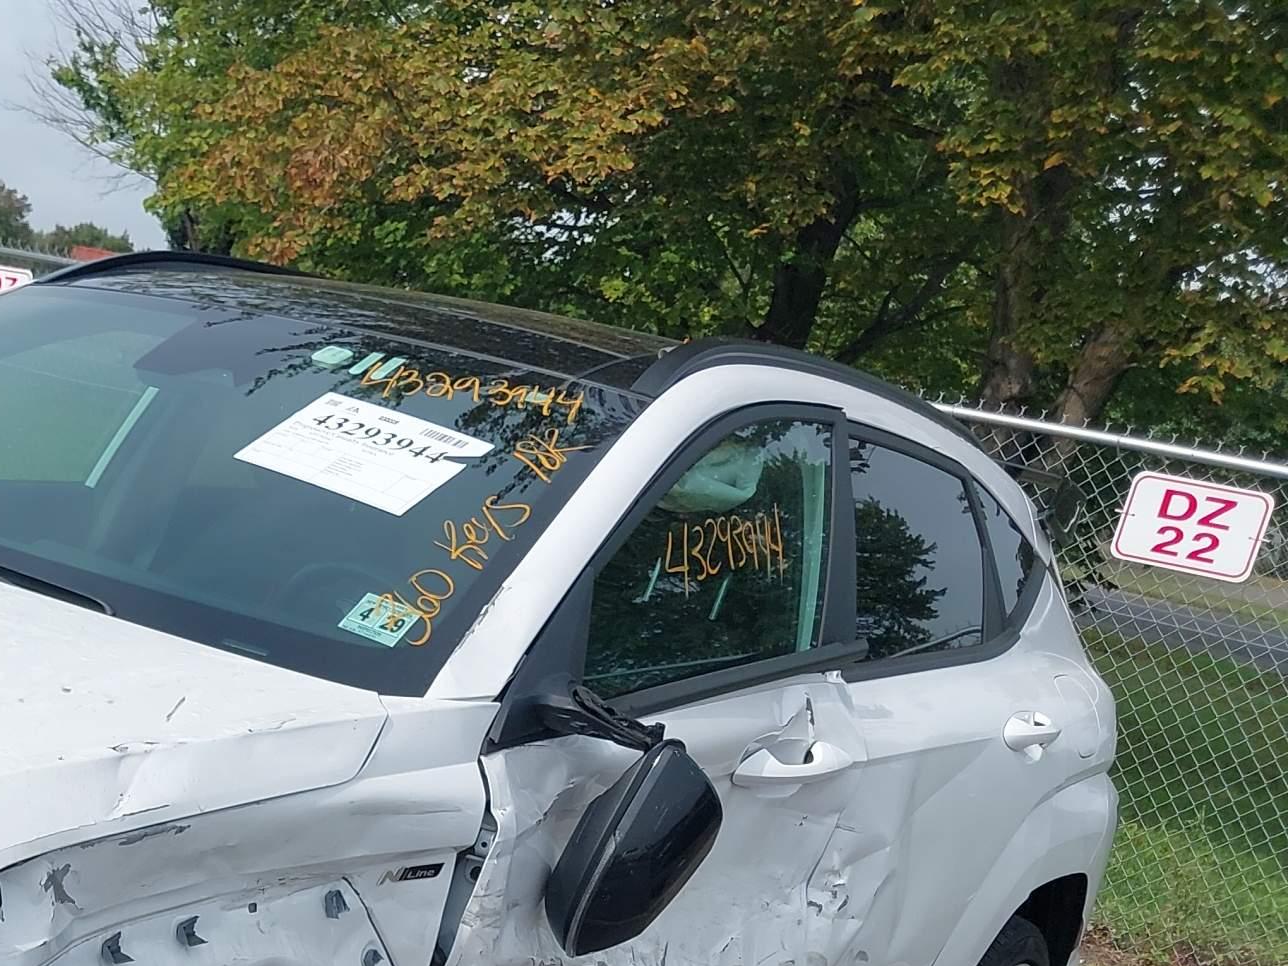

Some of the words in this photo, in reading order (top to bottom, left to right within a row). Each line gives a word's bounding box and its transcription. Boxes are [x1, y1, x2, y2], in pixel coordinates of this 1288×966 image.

[361, 361, 585, 425] 43293944
[313, 414, 448, 463] 43293944
[1157, 489, 1238, 531] DZ
[665, 502, 785, 599] 43293944
[1150, 526, 1220, 564] 22
[407, 868, 435, 878] Line
